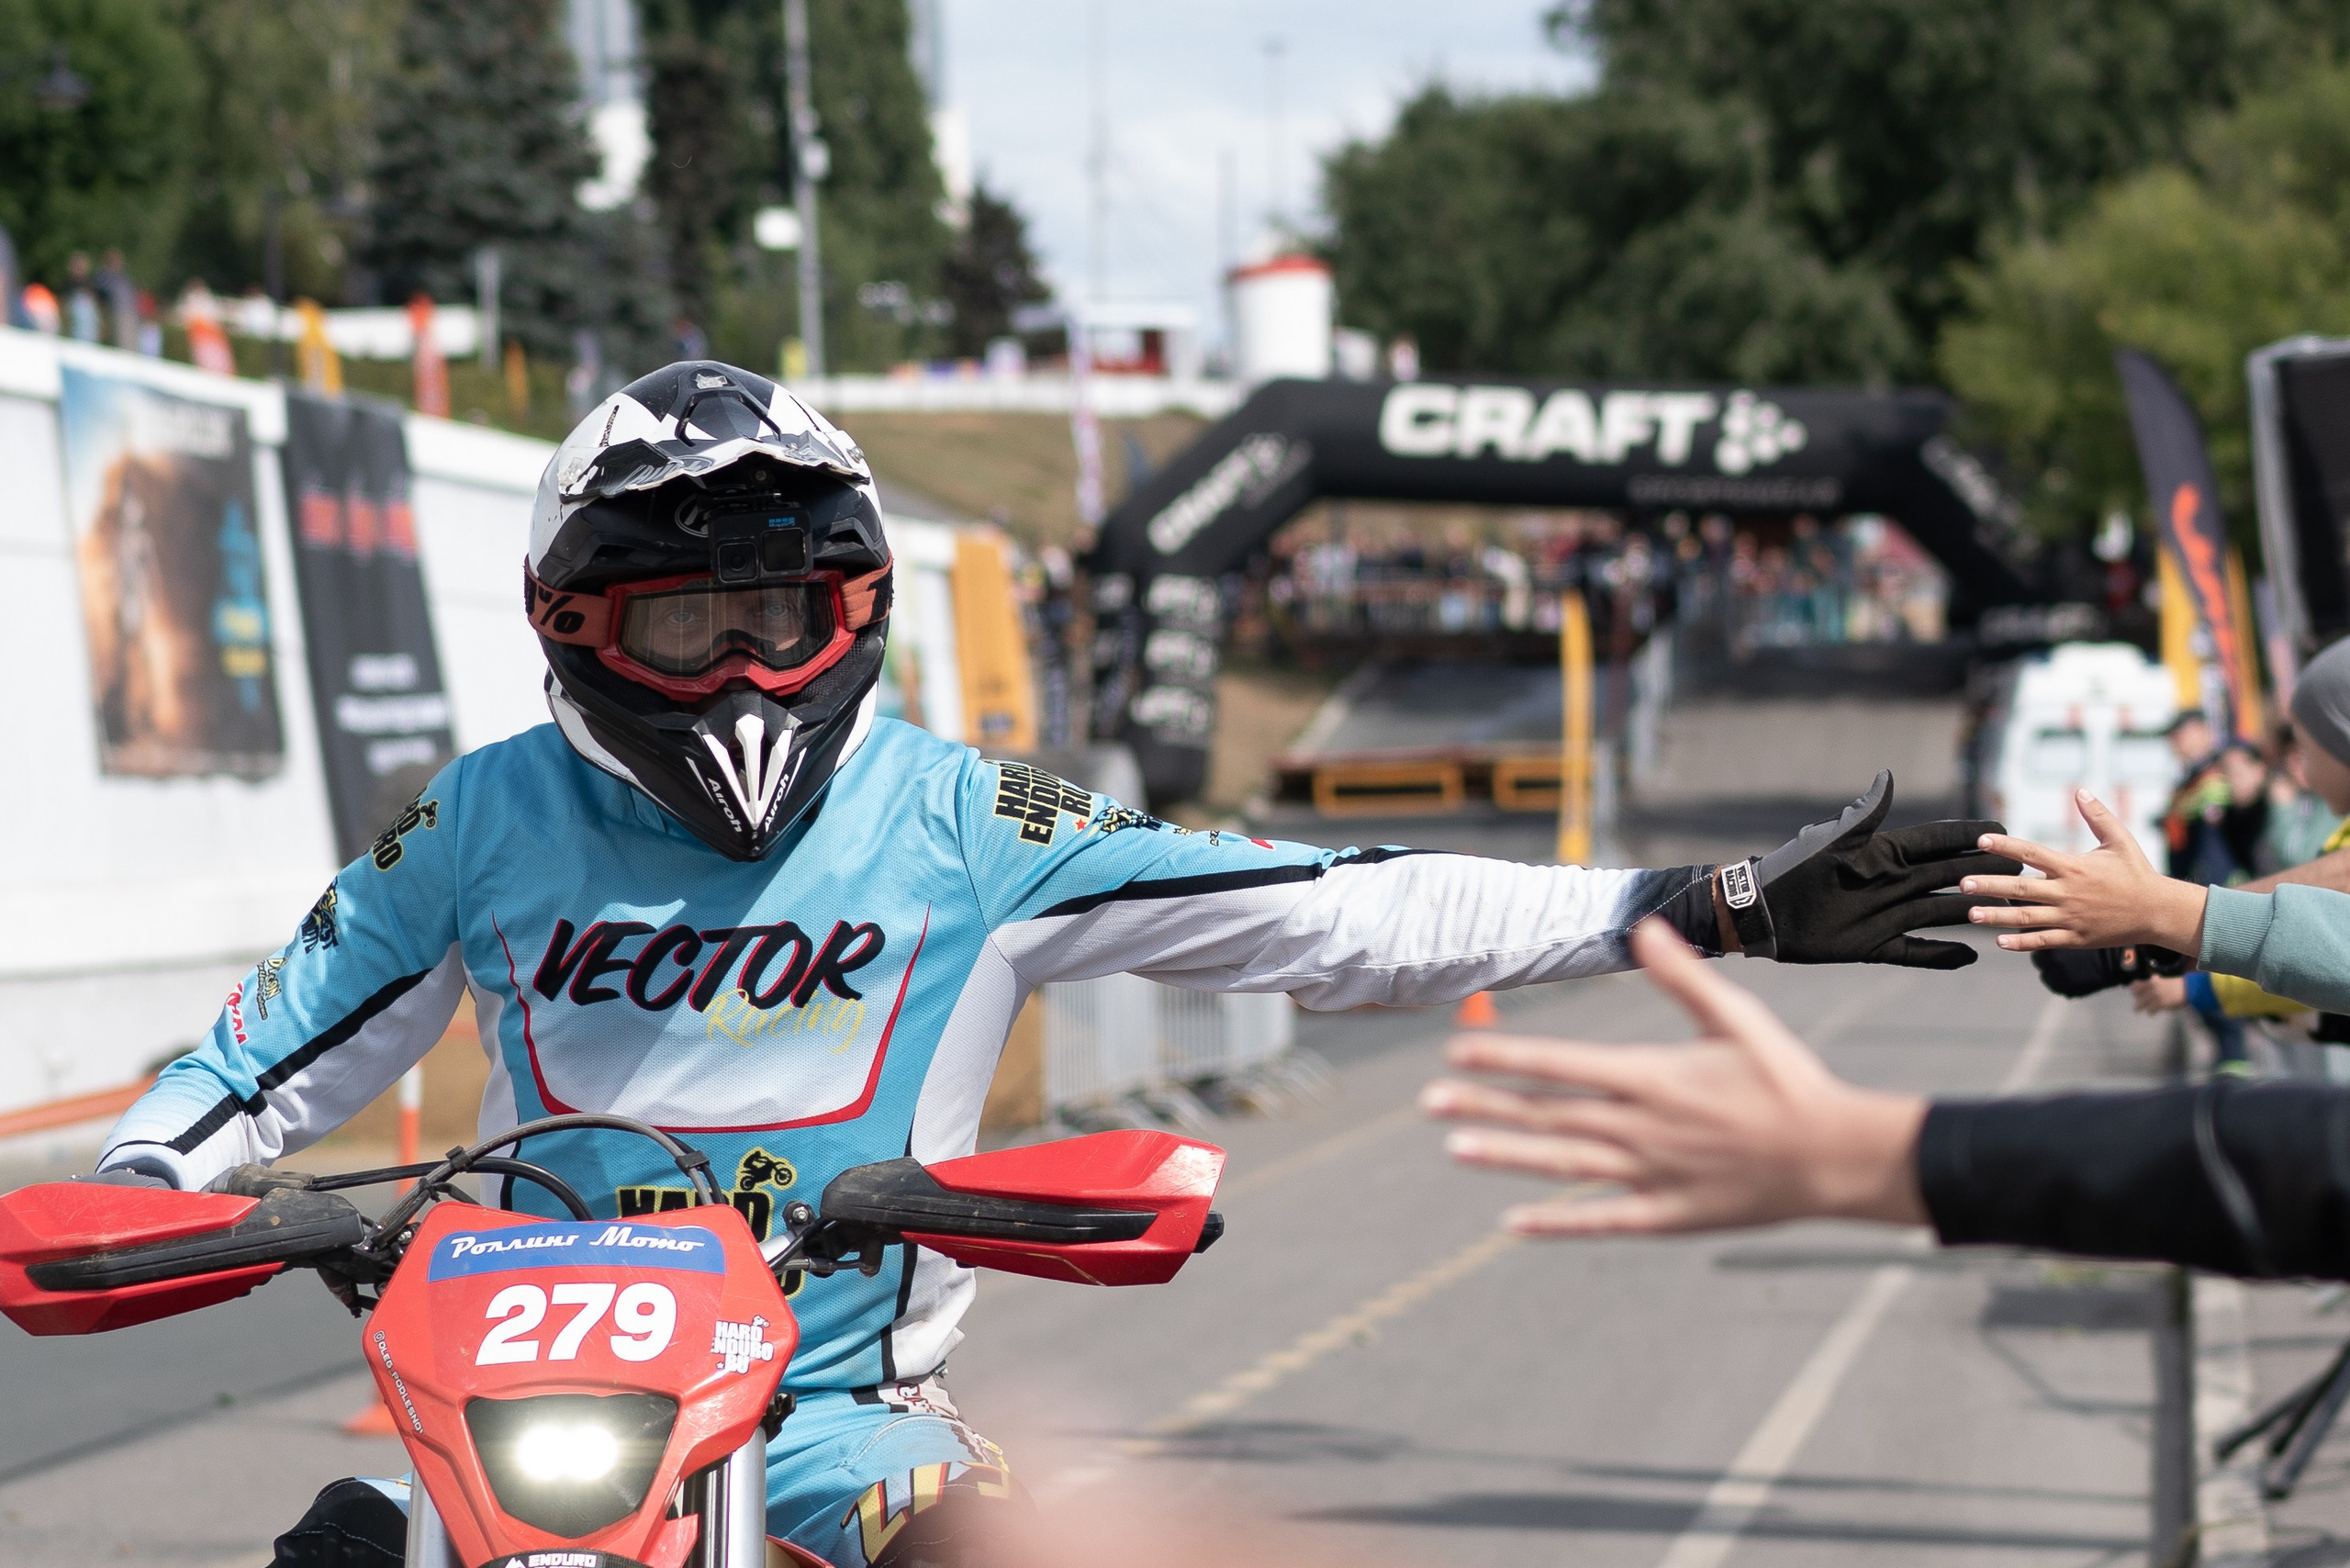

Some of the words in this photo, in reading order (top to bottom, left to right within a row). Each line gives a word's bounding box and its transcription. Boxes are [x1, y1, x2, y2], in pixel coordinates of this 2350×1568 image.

[1380, 383, 1718, 465] CRAFT
[533, 919, 885, 1014] VECTOR
[702, 988, 865, 1055] Racing
[451, 1234, 579, 1259] Роллинг
[588, 1226, 706, 1253] Мото
[475, 1282, 677, 1366] 279
[715, 1321, 764, 1341] HARD
[528, 1552, 597, 1568] ENDURO
